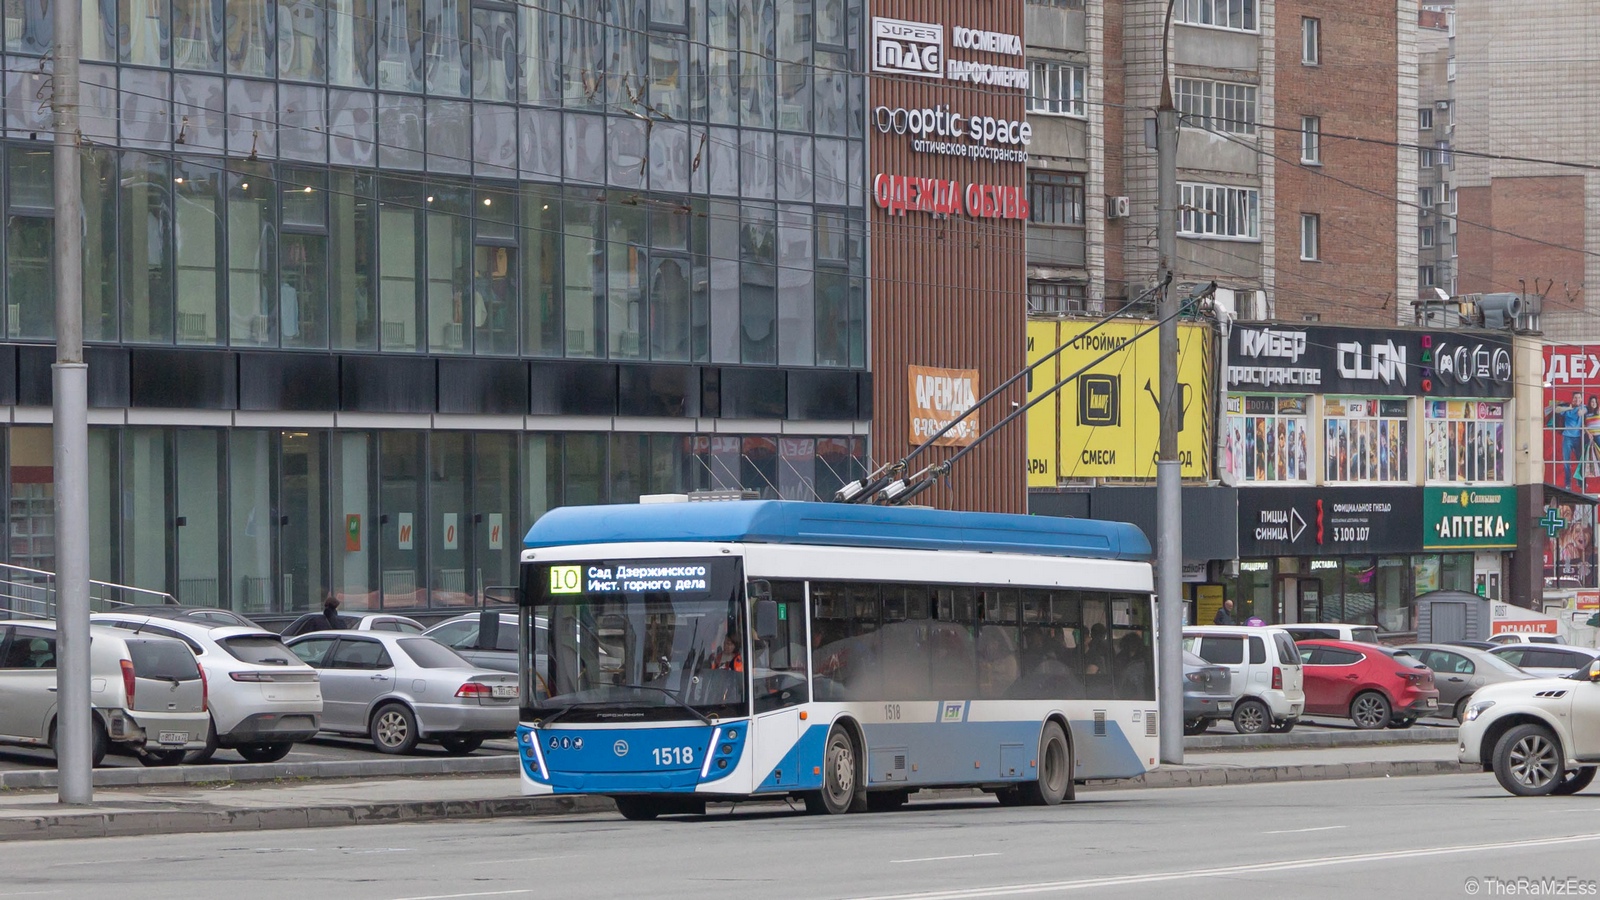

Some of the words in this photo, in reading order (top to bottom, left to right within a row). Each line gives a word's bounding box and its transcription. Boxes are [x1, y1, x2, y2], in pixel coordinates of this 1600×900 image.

[882, 25, 937, 40] SUPER
[952, 25, 1023, 56] КОСМЕТИКА
[947, 58, 1029, 90] ПАРФЮМЕРИЯ
[908, 104, 963, 138] optic
[969, 115, 1033, 146] space
[914, 139, 967, 157] оптическое
[968, 144, 1029, 164] пространство
[874, 173, 963, 219] ОДЕЖДА
[966, 183, 1030, 220] ОБУВЬ
[1072, 334, 1127, 352] СТРОЙМАТ
[1240, 328, 1307, 364] КИБЕР
[1336, 339, 1407, 387] CLAN
[916, 374, 976, 417] АРЕНДА
[1251, 400, 1270, 410] DOTA
[1082, 450, 1116, 465] СМЕСИ
[1027, 459, 1048, 474] АРЫ
[1442, 491, 1458, 504] Ваше
[1333, 503, 1372, 513] ОФИЦИАЛЬНОЕ
[1372, 503, 1391, 512] ГНЕЗДО
[1261, 510, 1288, 524] ПИЦЦА
[1255, 527, 1288, 541] СИНИЦА
[1333, 527, 1339, 541] 3
[1340, 527, 1355, 541] 100
[1356, 527, 1369, 541] 107
[1440, 515, 1505, 538] АПТЕКА
[588, 566, 612, 579] Сад
[616, 565, 706, 578] Дзержинского
[1240, 562, 1269, 571] ПИЦЦЕРИЯ
[1311, 560, 1338, 570] ДОСТАВКА
[552, 569, 578, 590] 10
[588, 579, 620, 591] Инст.
[624, 580, 671, 592] горного
[675, 578, 706, 591] дела
[884, 704, 901, 720] 1518
[652, 746, 694, 766] 1518
